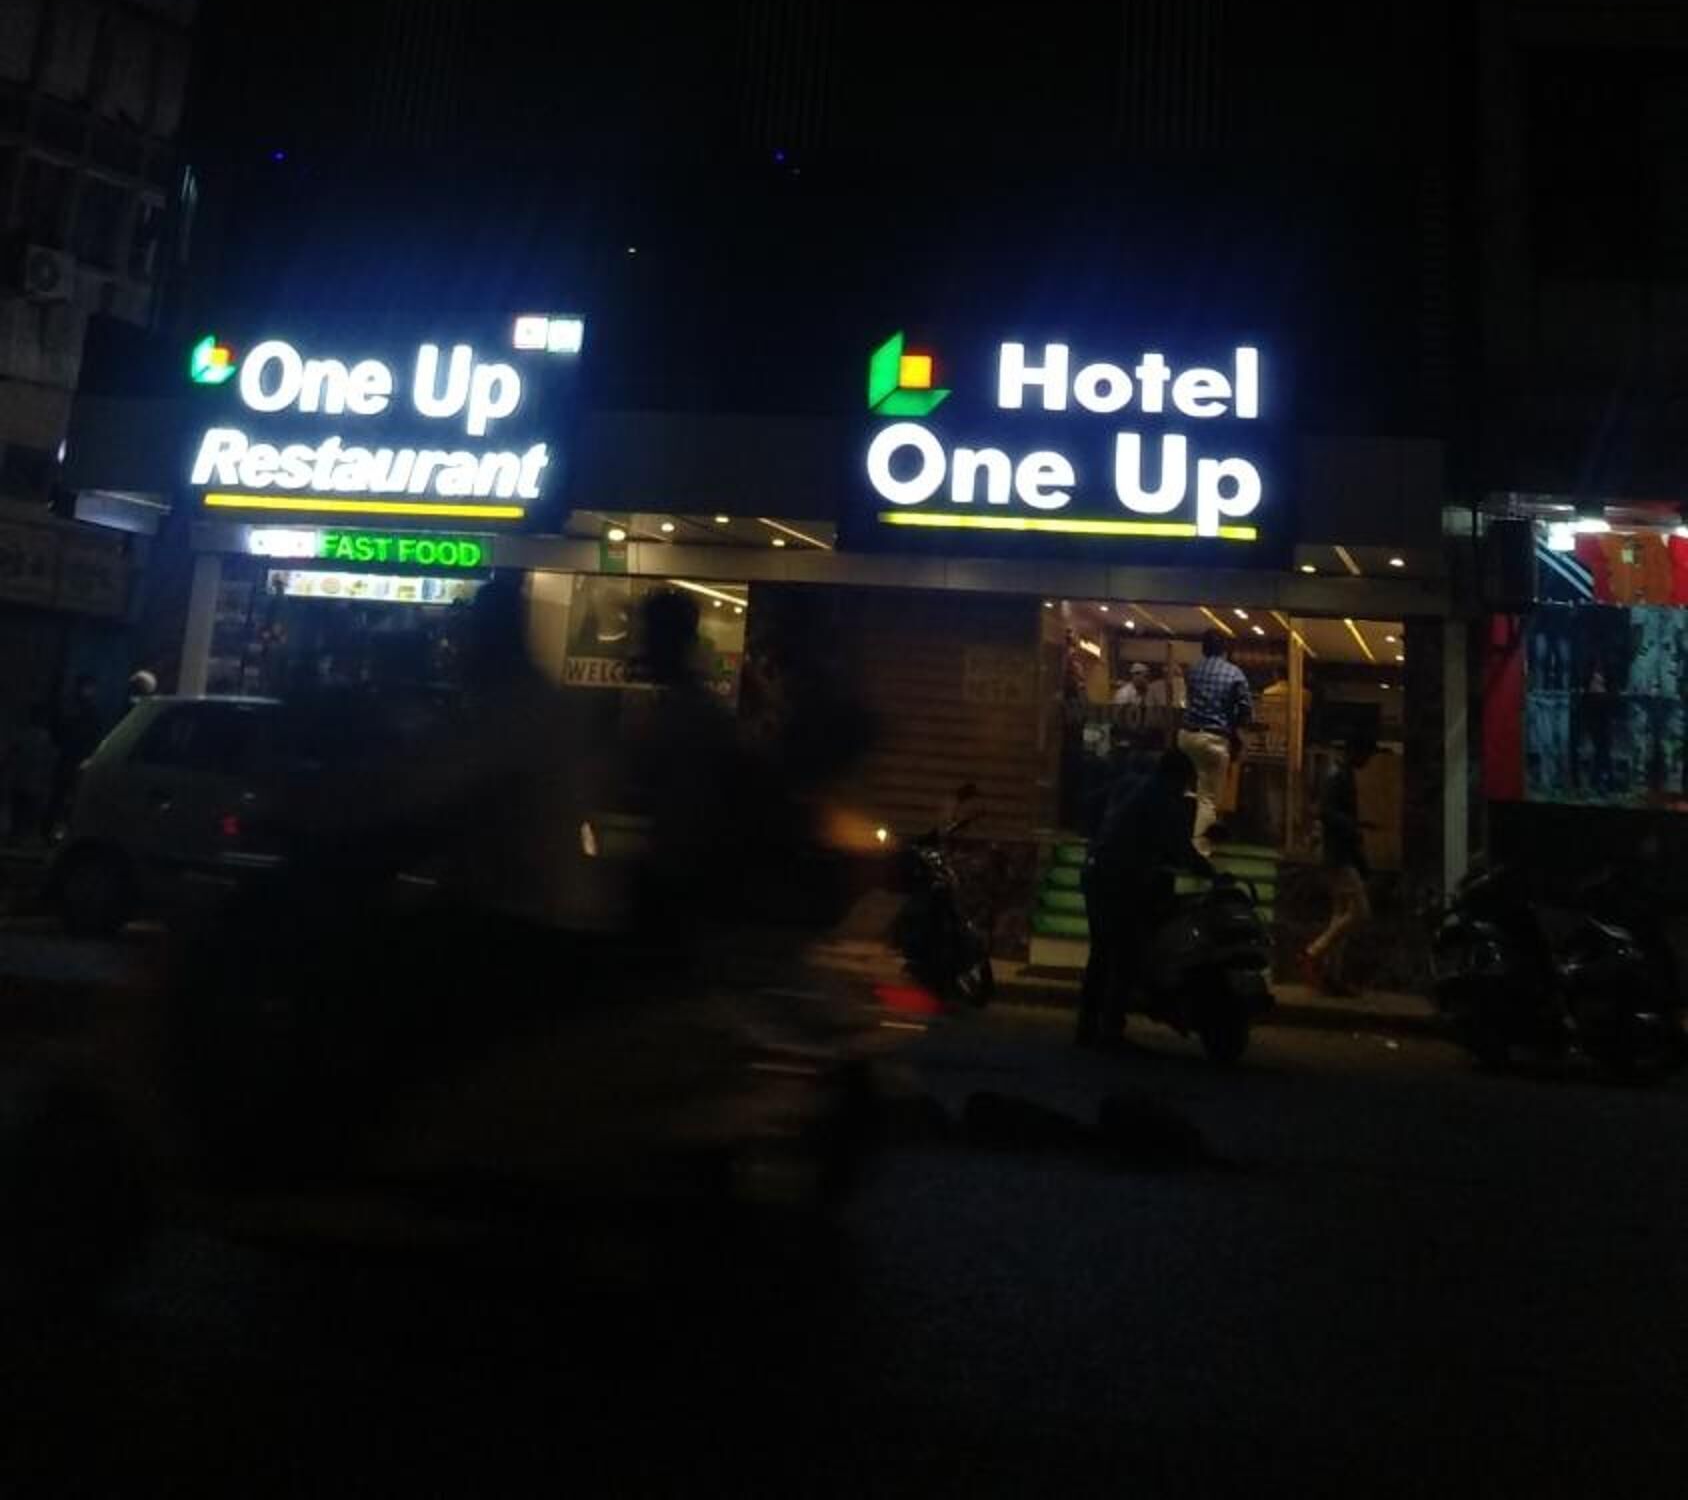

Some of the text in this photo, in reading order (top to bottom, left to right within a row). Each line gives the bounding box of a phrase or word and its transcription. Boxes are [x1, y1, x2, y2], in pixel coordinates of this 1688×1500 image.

[239, 340, 521, 436] One Up
[998, 342, 1260, 419] Hotel
[191, 428, 549, 498] Restaurant
[866, 422, 1262, 537] One Up
[320, 534, 482, 567] FAST FOOD
